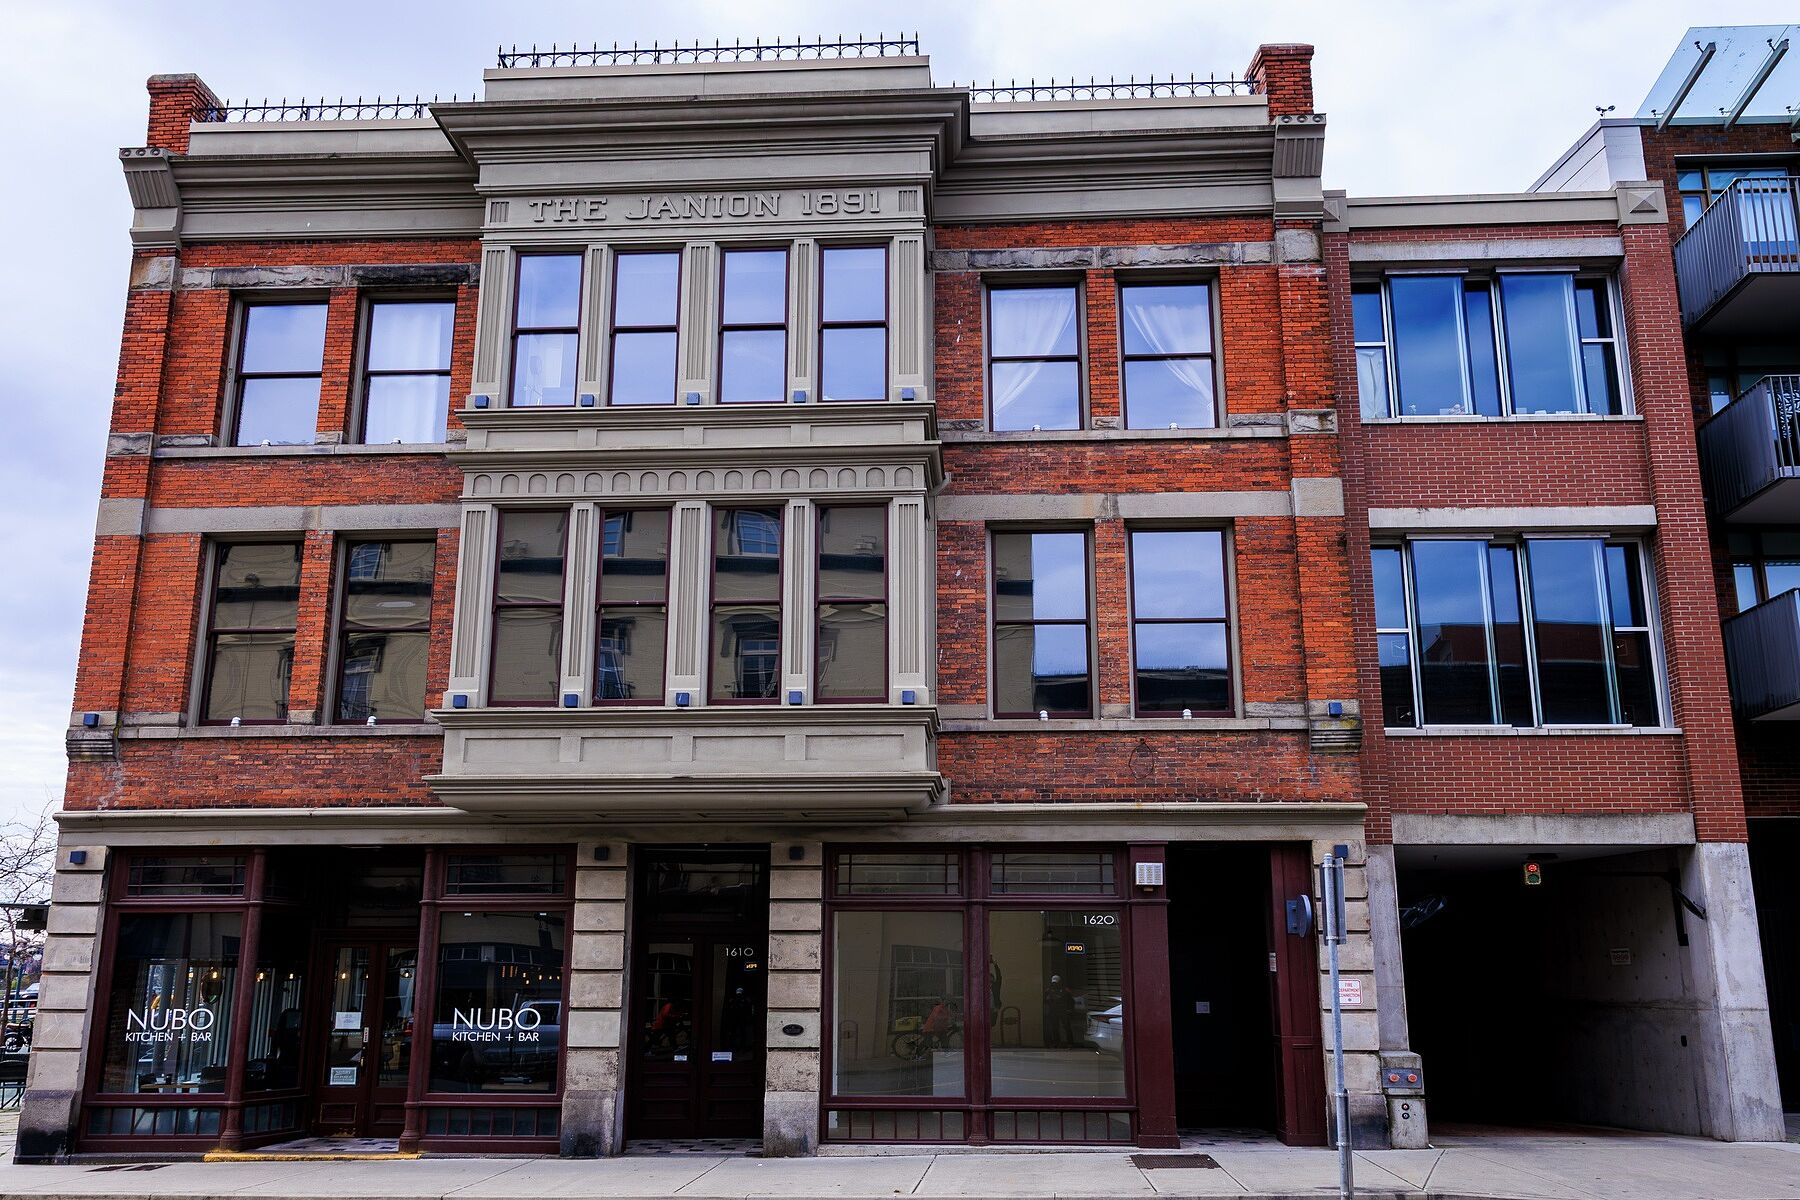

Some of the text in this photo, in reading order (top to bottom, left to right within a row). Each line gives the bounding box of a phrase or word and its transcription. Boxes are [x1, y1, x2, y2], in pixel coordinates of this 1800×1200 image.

[529, 190, 880, 222] THE JANION 1891
[1083, 915, 1115, 925] 1620
[725, 947, 754, 957] 1610
[126, 1008, 214, 1030] NUBO
[453, 1007, 541, 1030] NUBO
[125, 1032, 173, 1042] KITCHEN
[191, 1032, 212, 1042] BAR
[452, 1032, 500, 1042] KITCHEN
[518, 1032, 540, 1042] BAR
